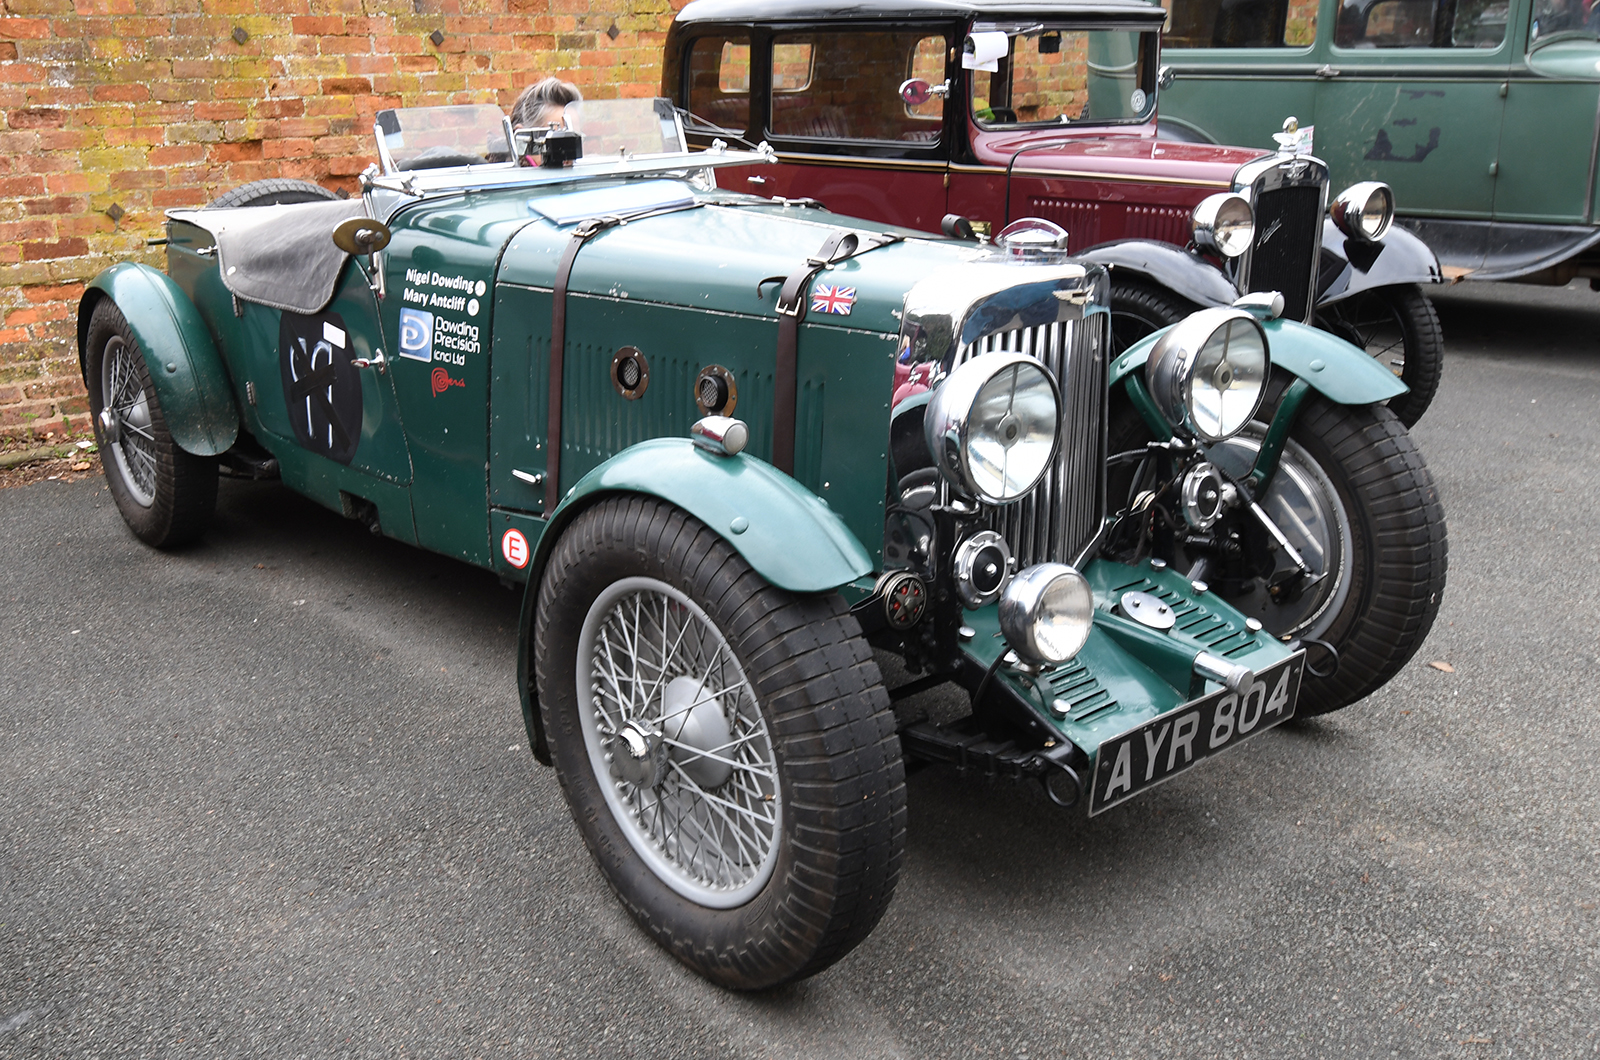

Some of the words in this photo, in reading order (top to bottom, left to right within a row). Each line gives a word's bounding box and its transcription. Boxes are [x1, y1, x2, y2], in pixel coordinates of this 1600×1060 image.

[405, 268, 431, 286] Nigel
[431, 272, 475, 295] Dowding
[403, 287, 429, 307] Mary
[429, 293, 466, 312] Antcliff
[435, 316, 479, 341] Dowding
[434, 331, 481, 354] Precision
[452, 352, 466, 366] Ltd
[509, 536, 521, 561] E
[1103, 710, 1201, 802] AYR
[1208, 665, 1292, 749] 804
